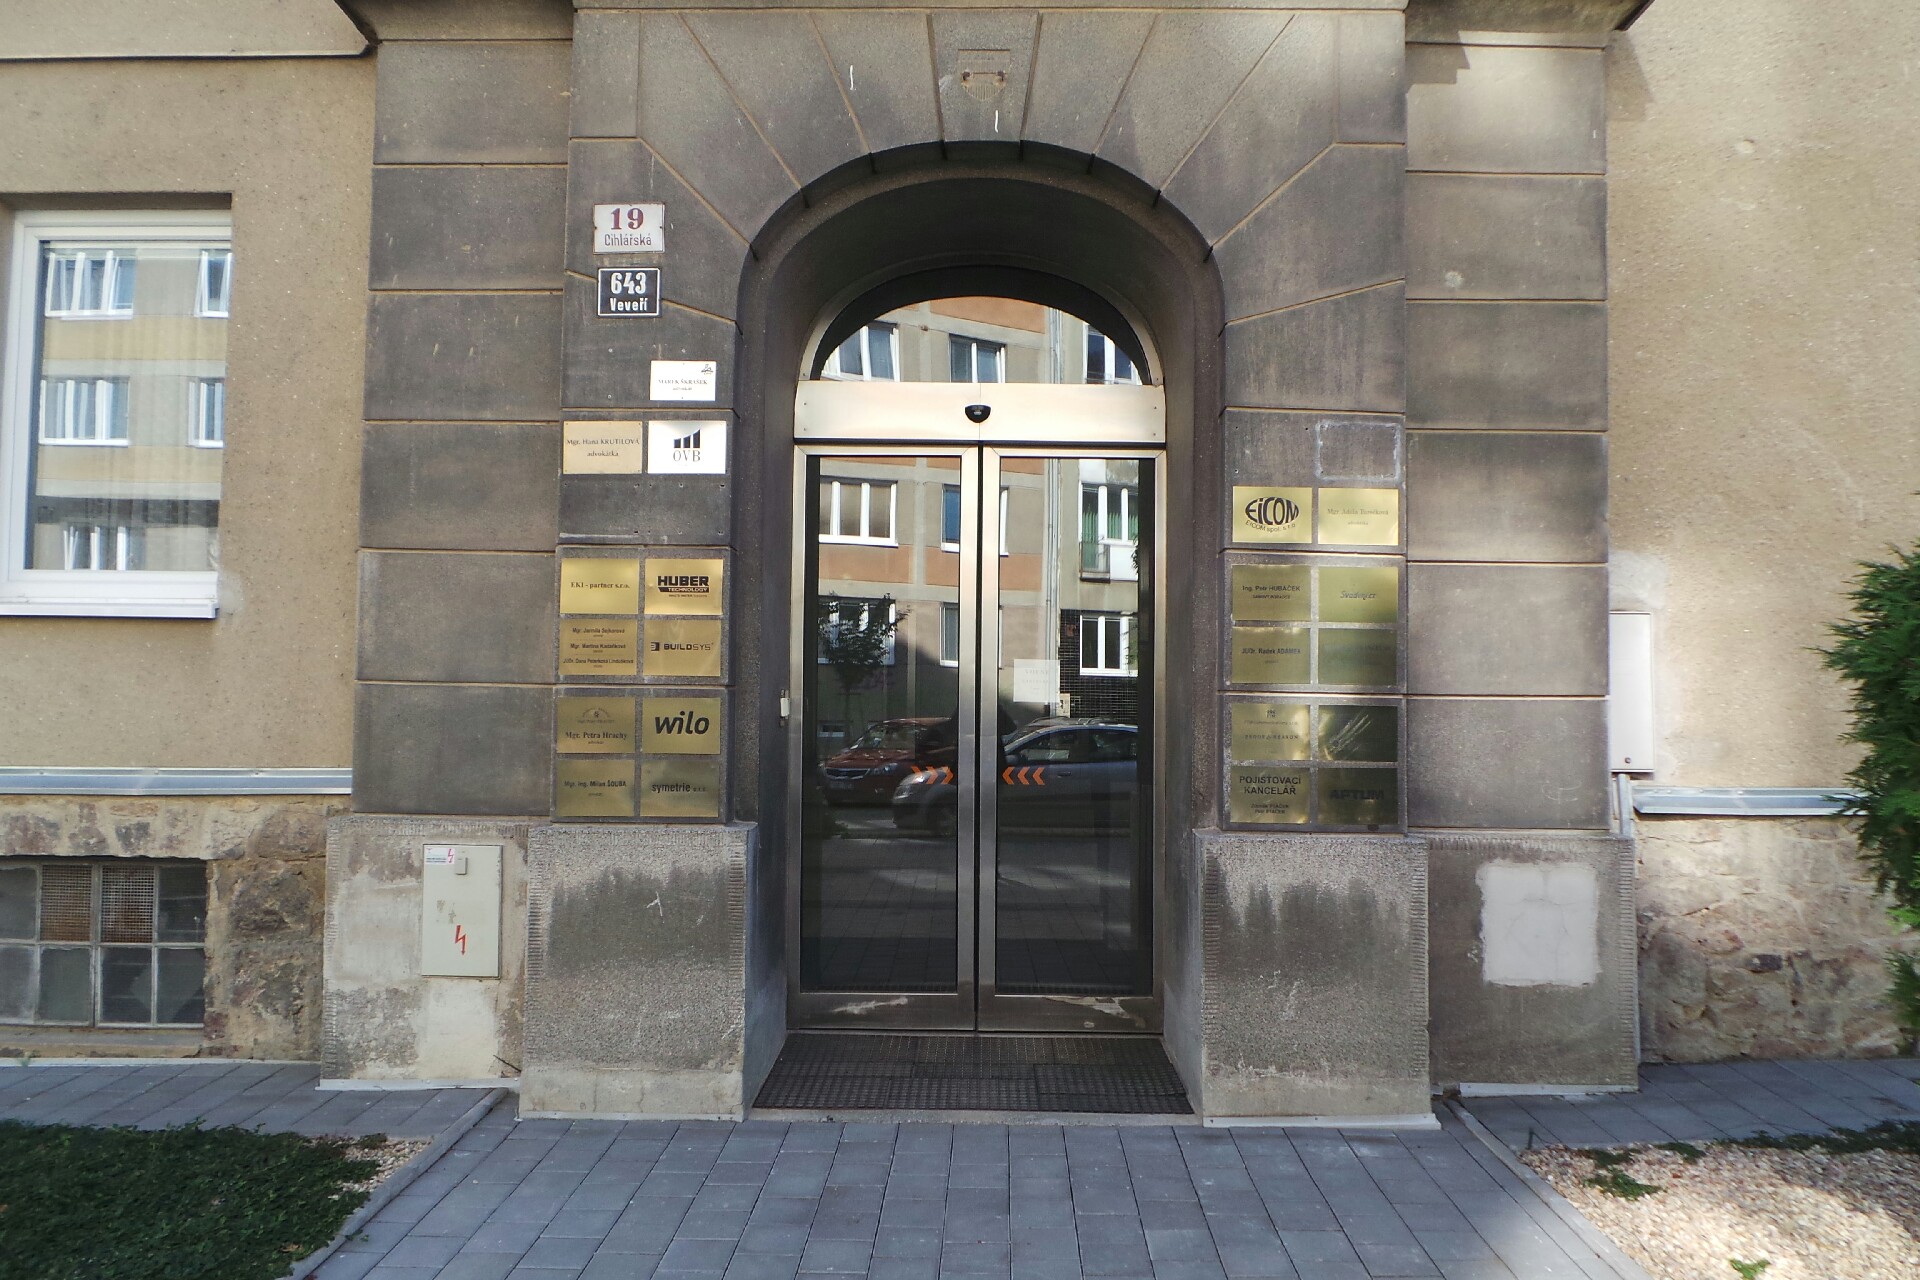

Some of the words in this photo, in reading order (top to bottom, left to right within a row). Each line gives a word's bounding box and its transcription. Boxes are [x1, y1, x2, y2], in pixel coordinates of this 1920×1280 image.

[610, 207, 644, 230] 19
[604, 233, 652, 246] Cihlářská
[610, 272, 647, 294] 643
[609, 297, 648, 312] Veveří
[672, 449, 701, 462] OVB
[657, 575, 709, 587] HUBER
[663, 643, 711, 651] BUILDSYS
[654, 710, 710, 735] wilo
[651, 782, 691, 794] symetrie
